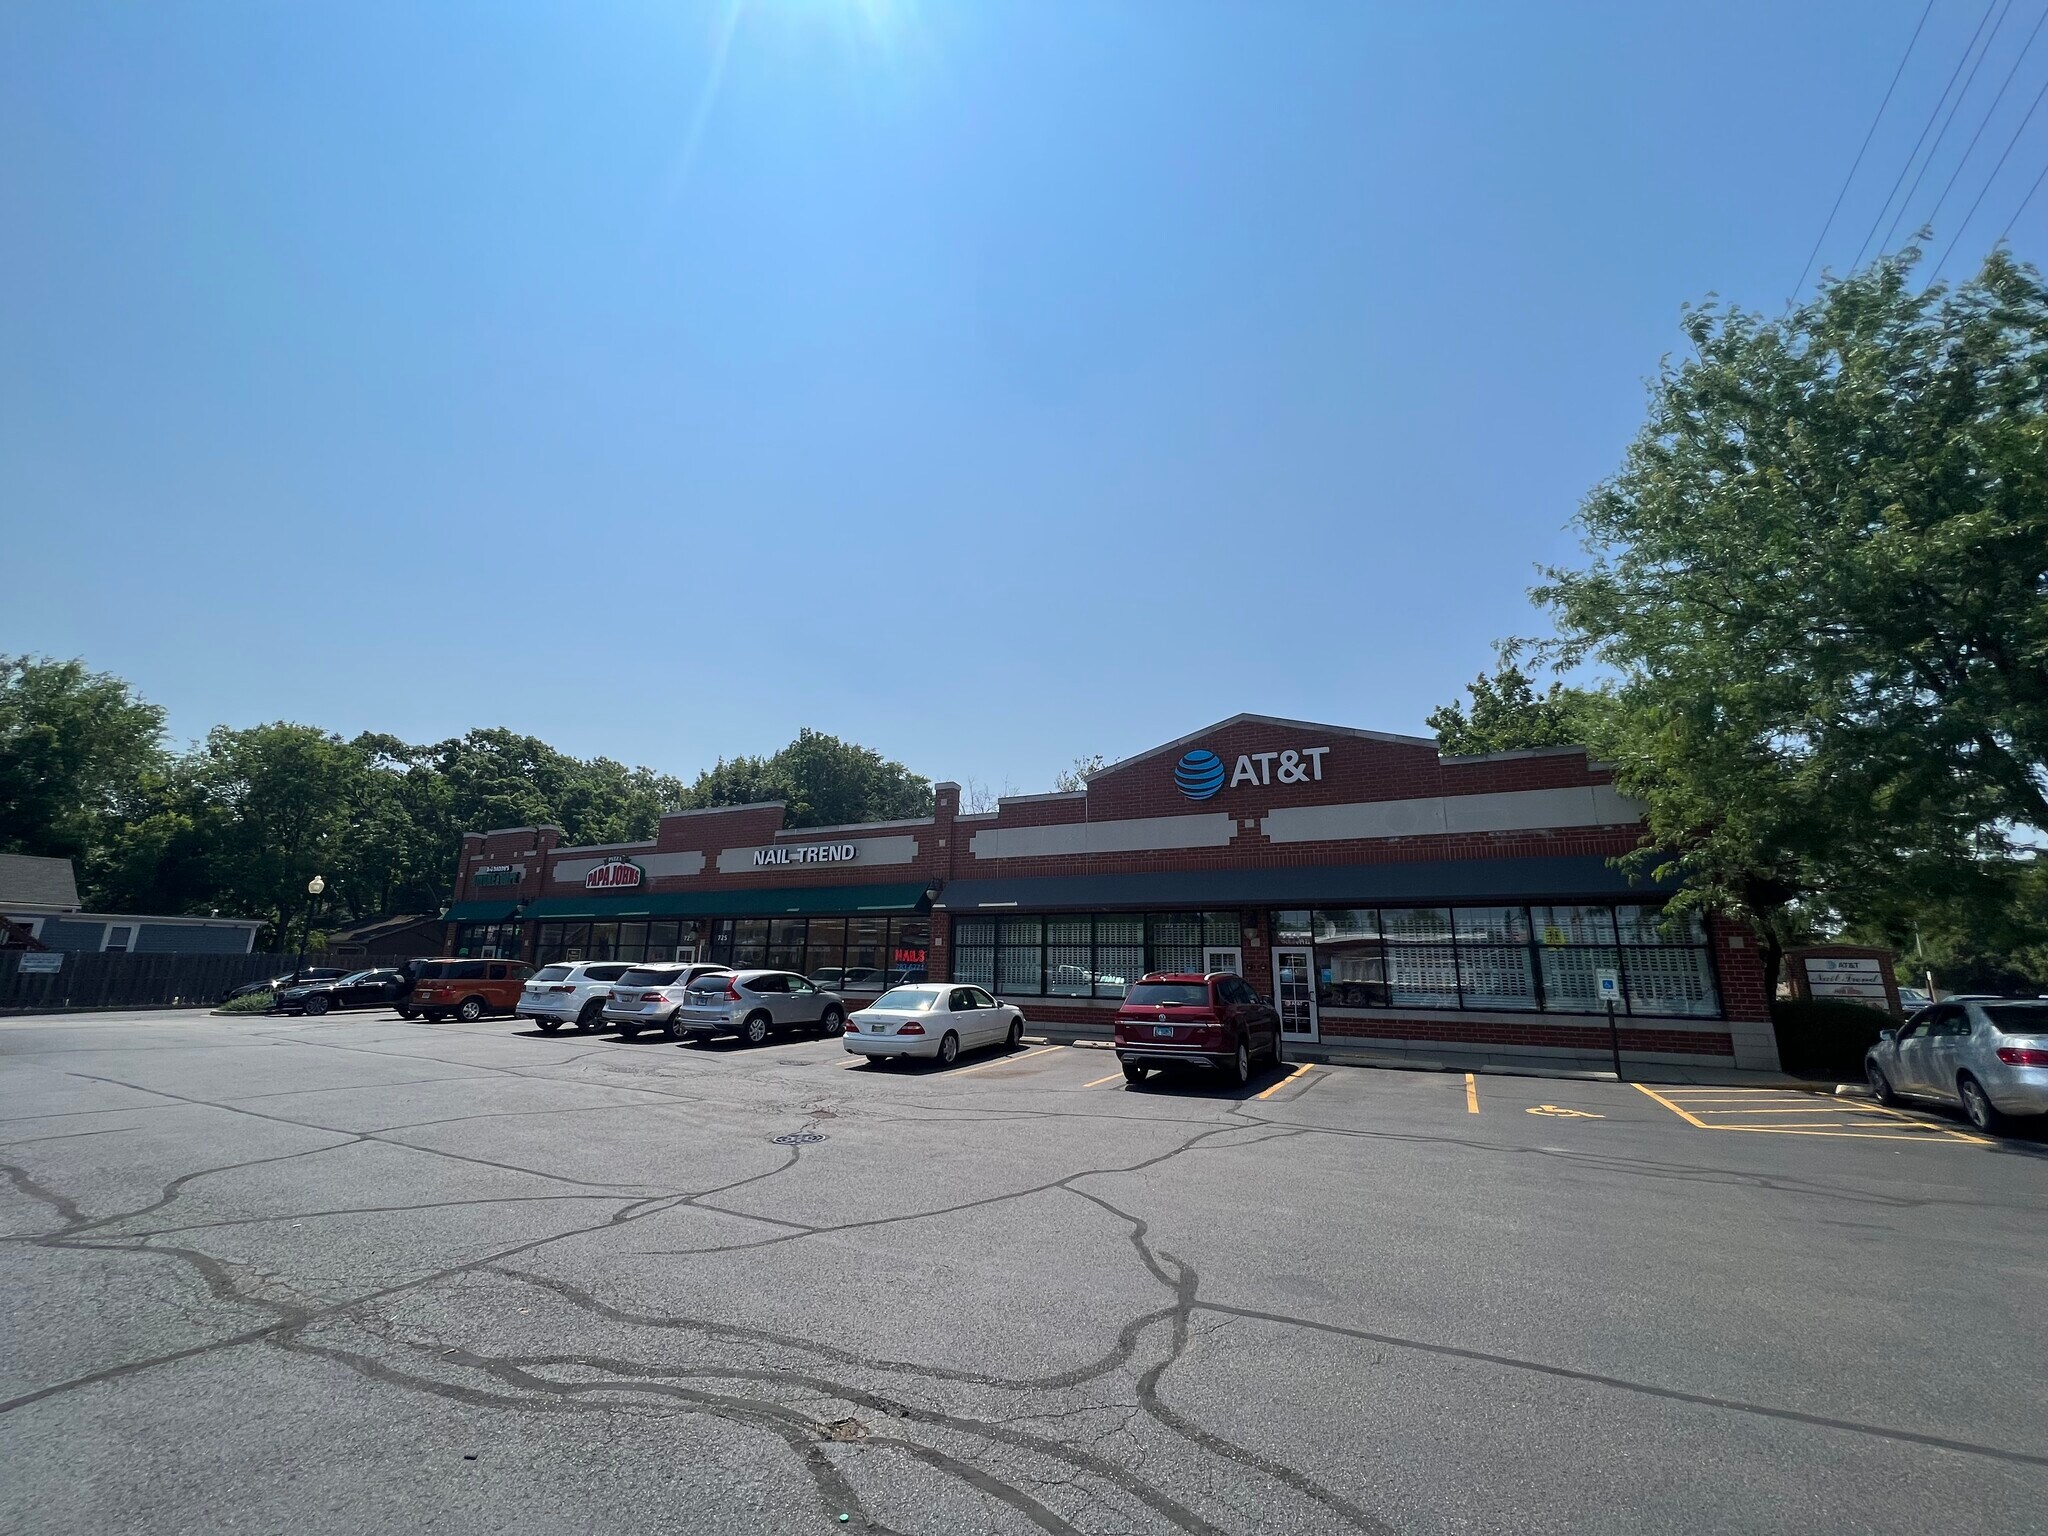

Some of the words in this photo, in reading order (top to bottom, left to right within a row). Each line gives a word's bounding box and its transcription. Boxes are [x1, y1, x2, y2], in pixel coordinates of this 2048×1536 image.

[1229, 747, 1330, 788] AT&T
[753, 849, 790, 865] NAIL
[797, 844, 855, 863] TREND
[587, 866, 610, 887] PAPA
[895, 949, 925, 962] NAILS
